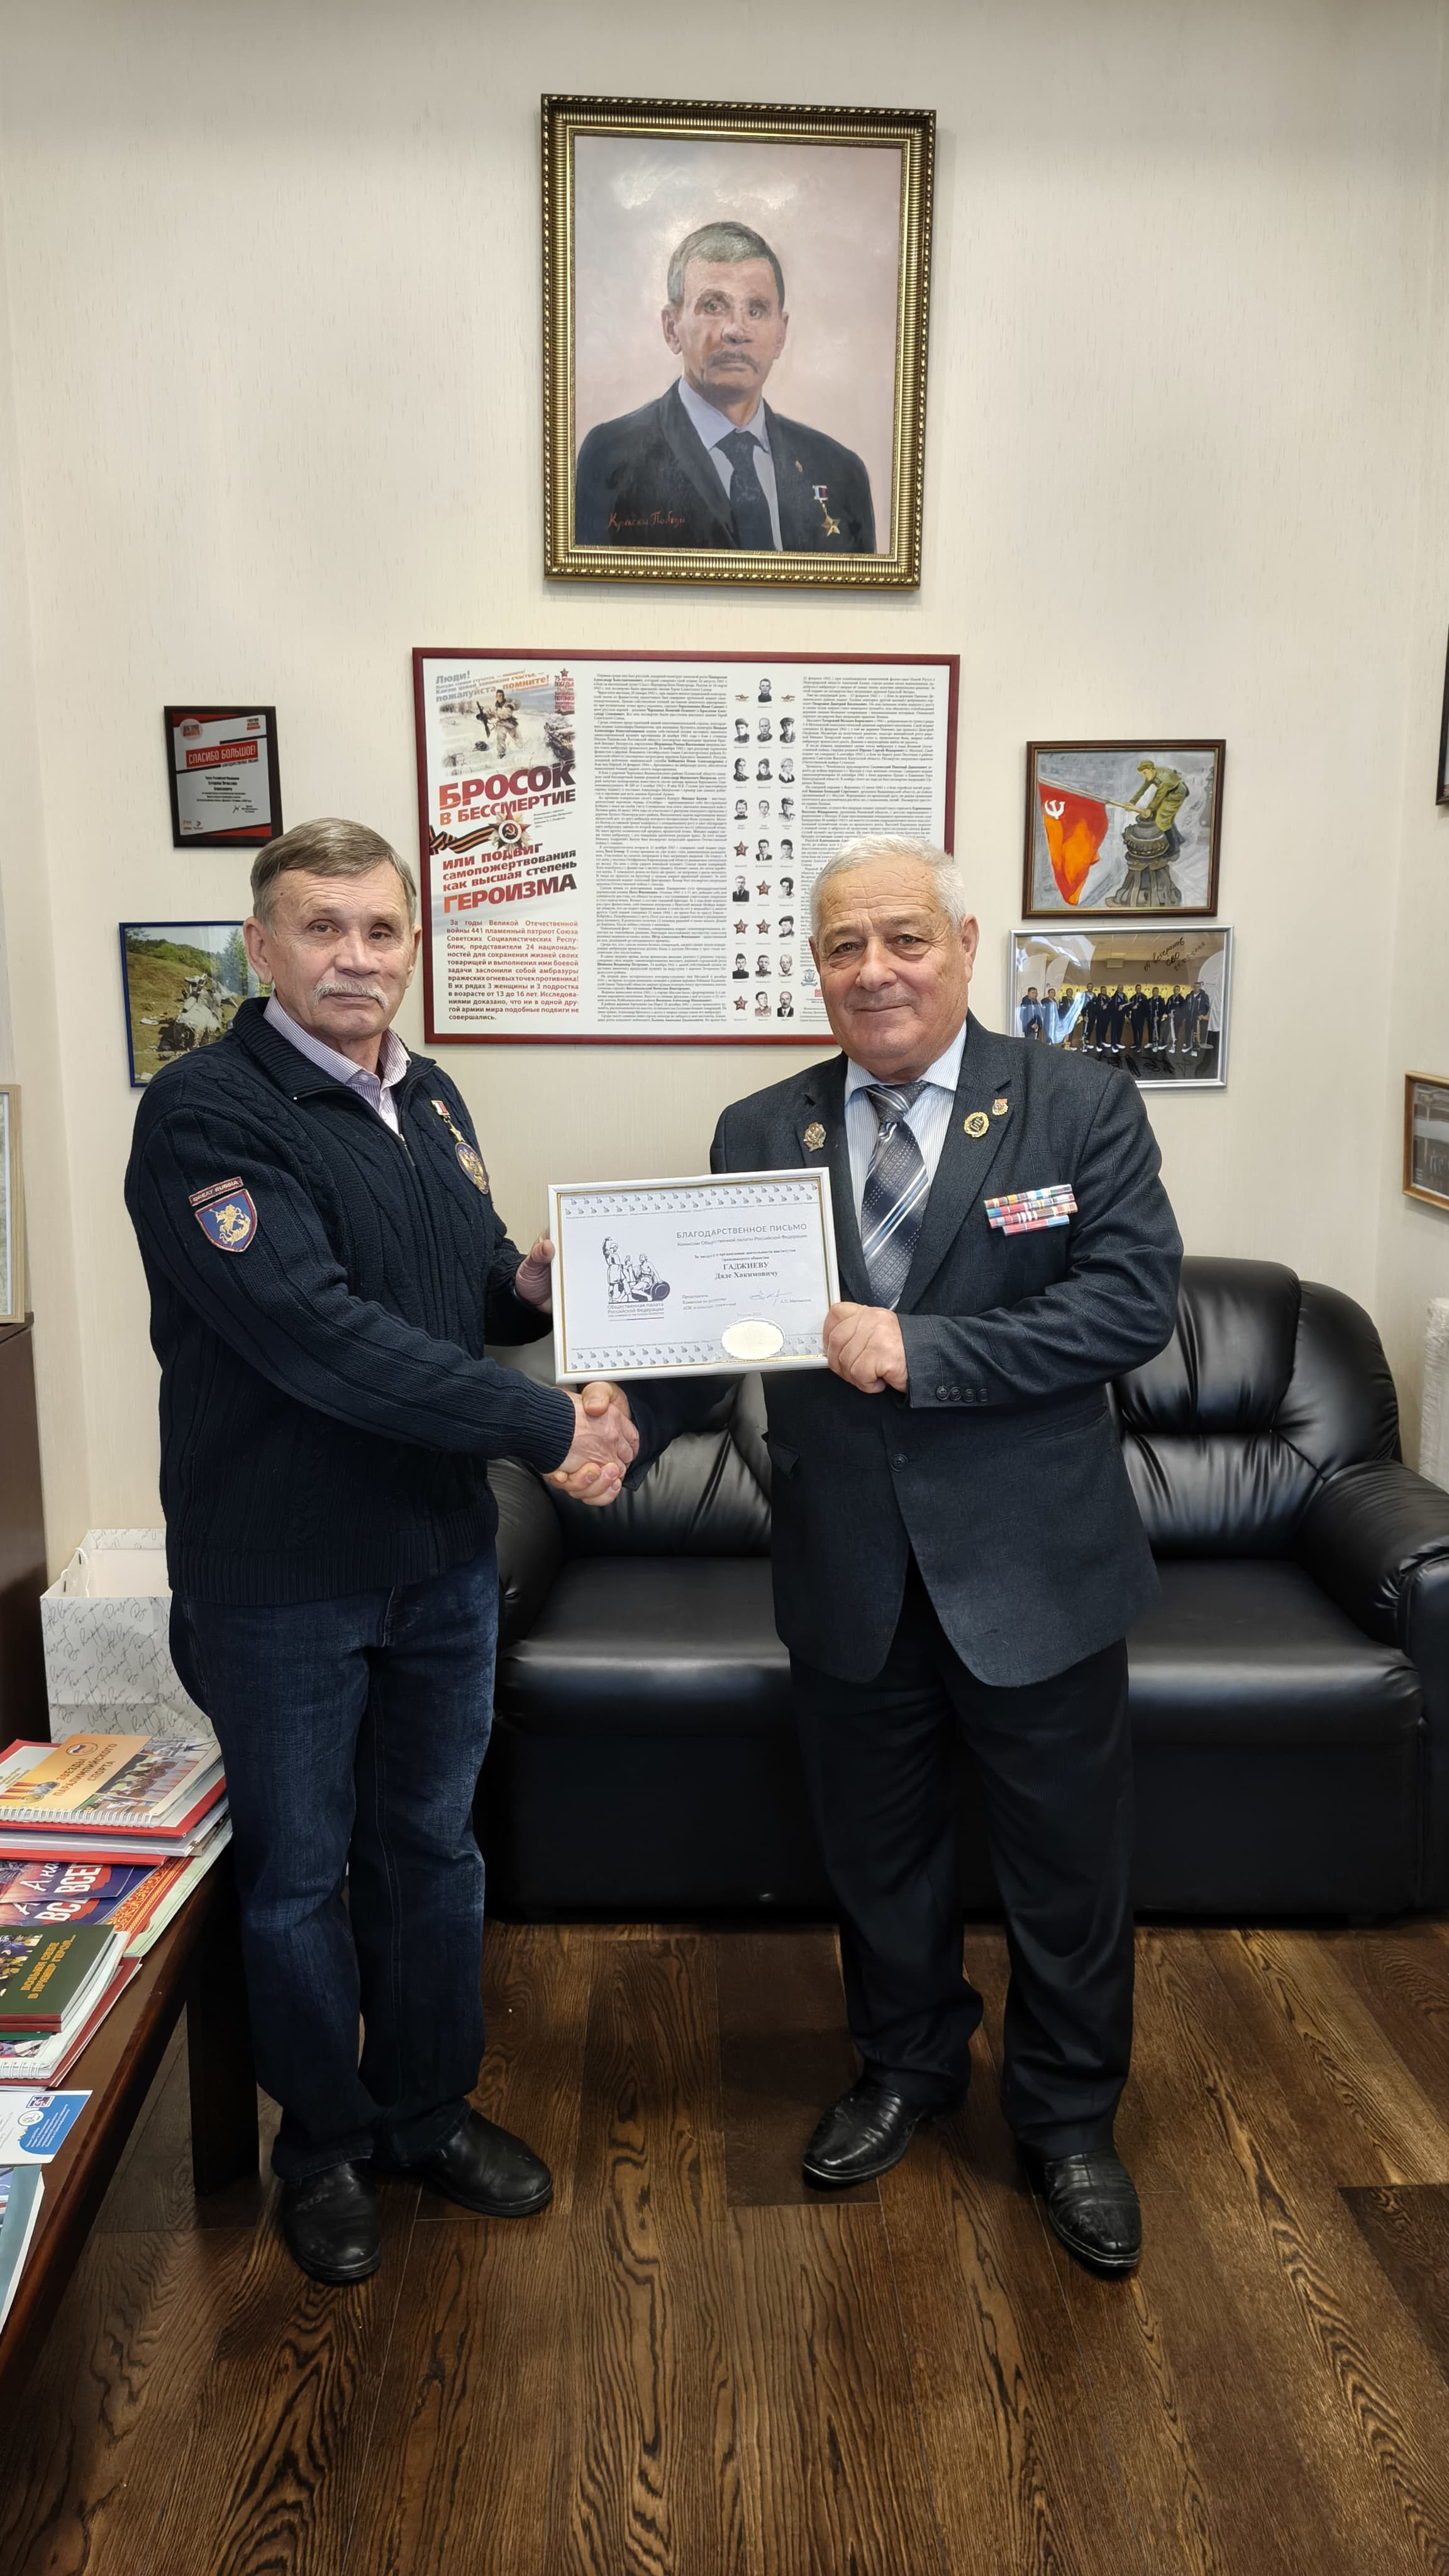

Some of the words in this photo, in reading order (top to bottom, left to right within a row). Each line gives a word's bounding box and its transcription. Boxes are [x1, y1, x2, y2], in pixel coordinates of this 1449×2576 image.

[436, 670, 470, 684] Люди!
[502, 675, 549, 689] помните!
[189, 750, 219, 765] СПАСИБО
[221, 745, 256, 759] БОЛЬШОЕ!
[439, 762, 576, 810] БРОСОК
[440, 812, 452, 826] В
[458, 789, 576, 823] БЕССМЕРТИЕ
[443, 850, 576, 880] самопожертвования
[443, 880, 467, 892] как
[472, 870, 522, 887] высшая
[526, 860, 577, 876] степень
[444, 874, 577, 913] ГЕРОИЗМА
[193, 1189, 214, 1202] GREAT
[214, 1180, 239, 1192] RUSSIA
[677, 1226, 767, 1238] БЛАГОДАРСТВЕННОЕ
[770, 1223, 808, 1232] ПИСЬМО
[52, 1743, 118, 1796] ПАРАЛИМПИЙСКОГО
[56, 1758, 87, 1780] ЗВЕЗДЫ
[87, 1761, 116, 1781] СПОРТА
[19, 1880, 52, 1892] А
